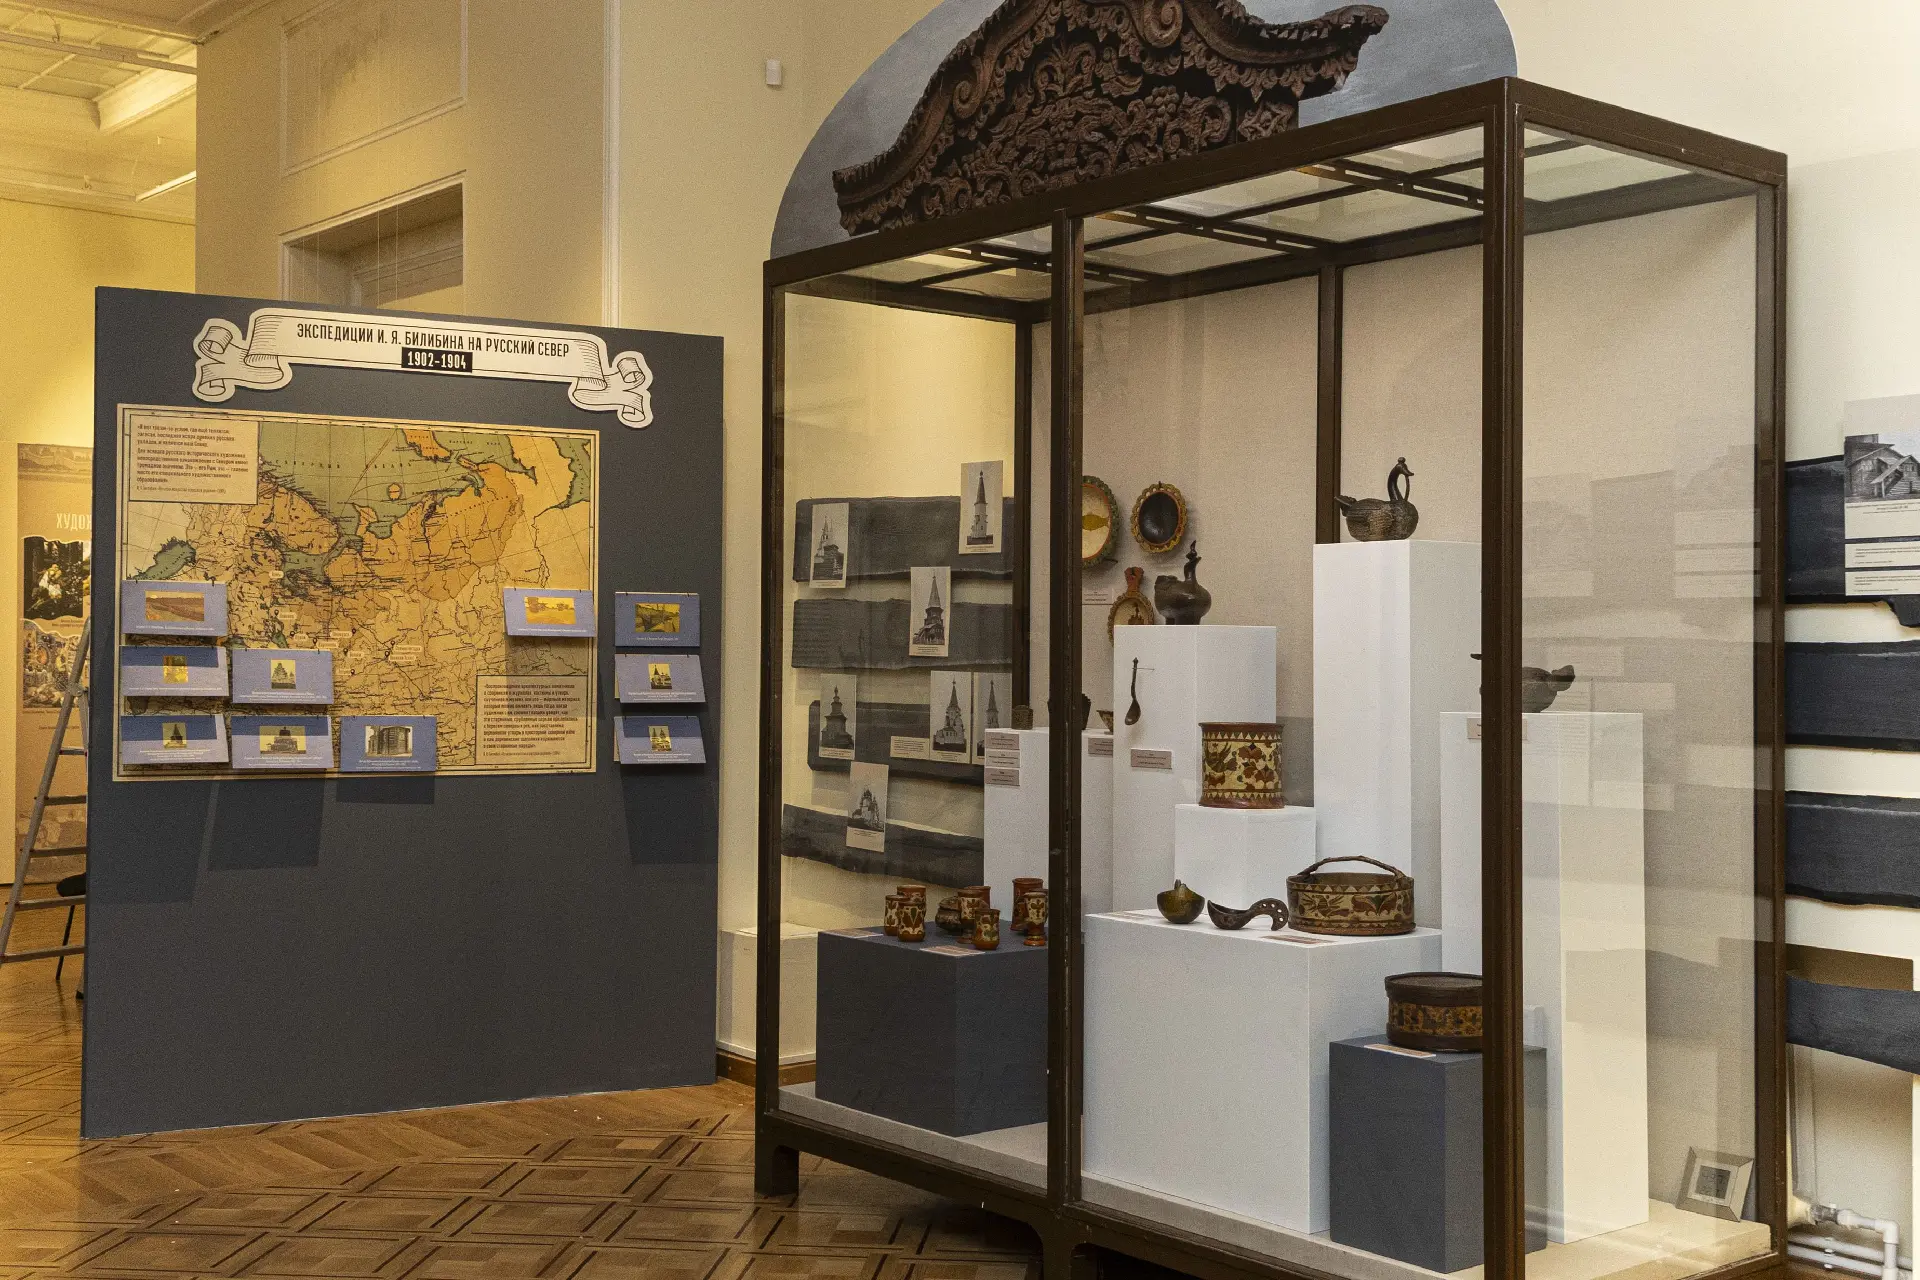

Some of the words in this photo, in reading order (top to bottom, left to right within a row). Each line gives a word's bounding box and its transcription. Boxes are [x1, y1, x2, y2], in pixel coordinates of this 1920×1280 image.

[297, 323, 373, 343] ЭКСПЕДИЦИИ
[378, 329, 387, 344] И.
[391, 330, 401, 345] Я.
[405, 332, 464, 350] БИЛИБИНА
[468, 337, 482, 351] НА
[486, 338, 535, 355] РУССКИЙ
[538, 342, 570, 357] СЕВЕР
